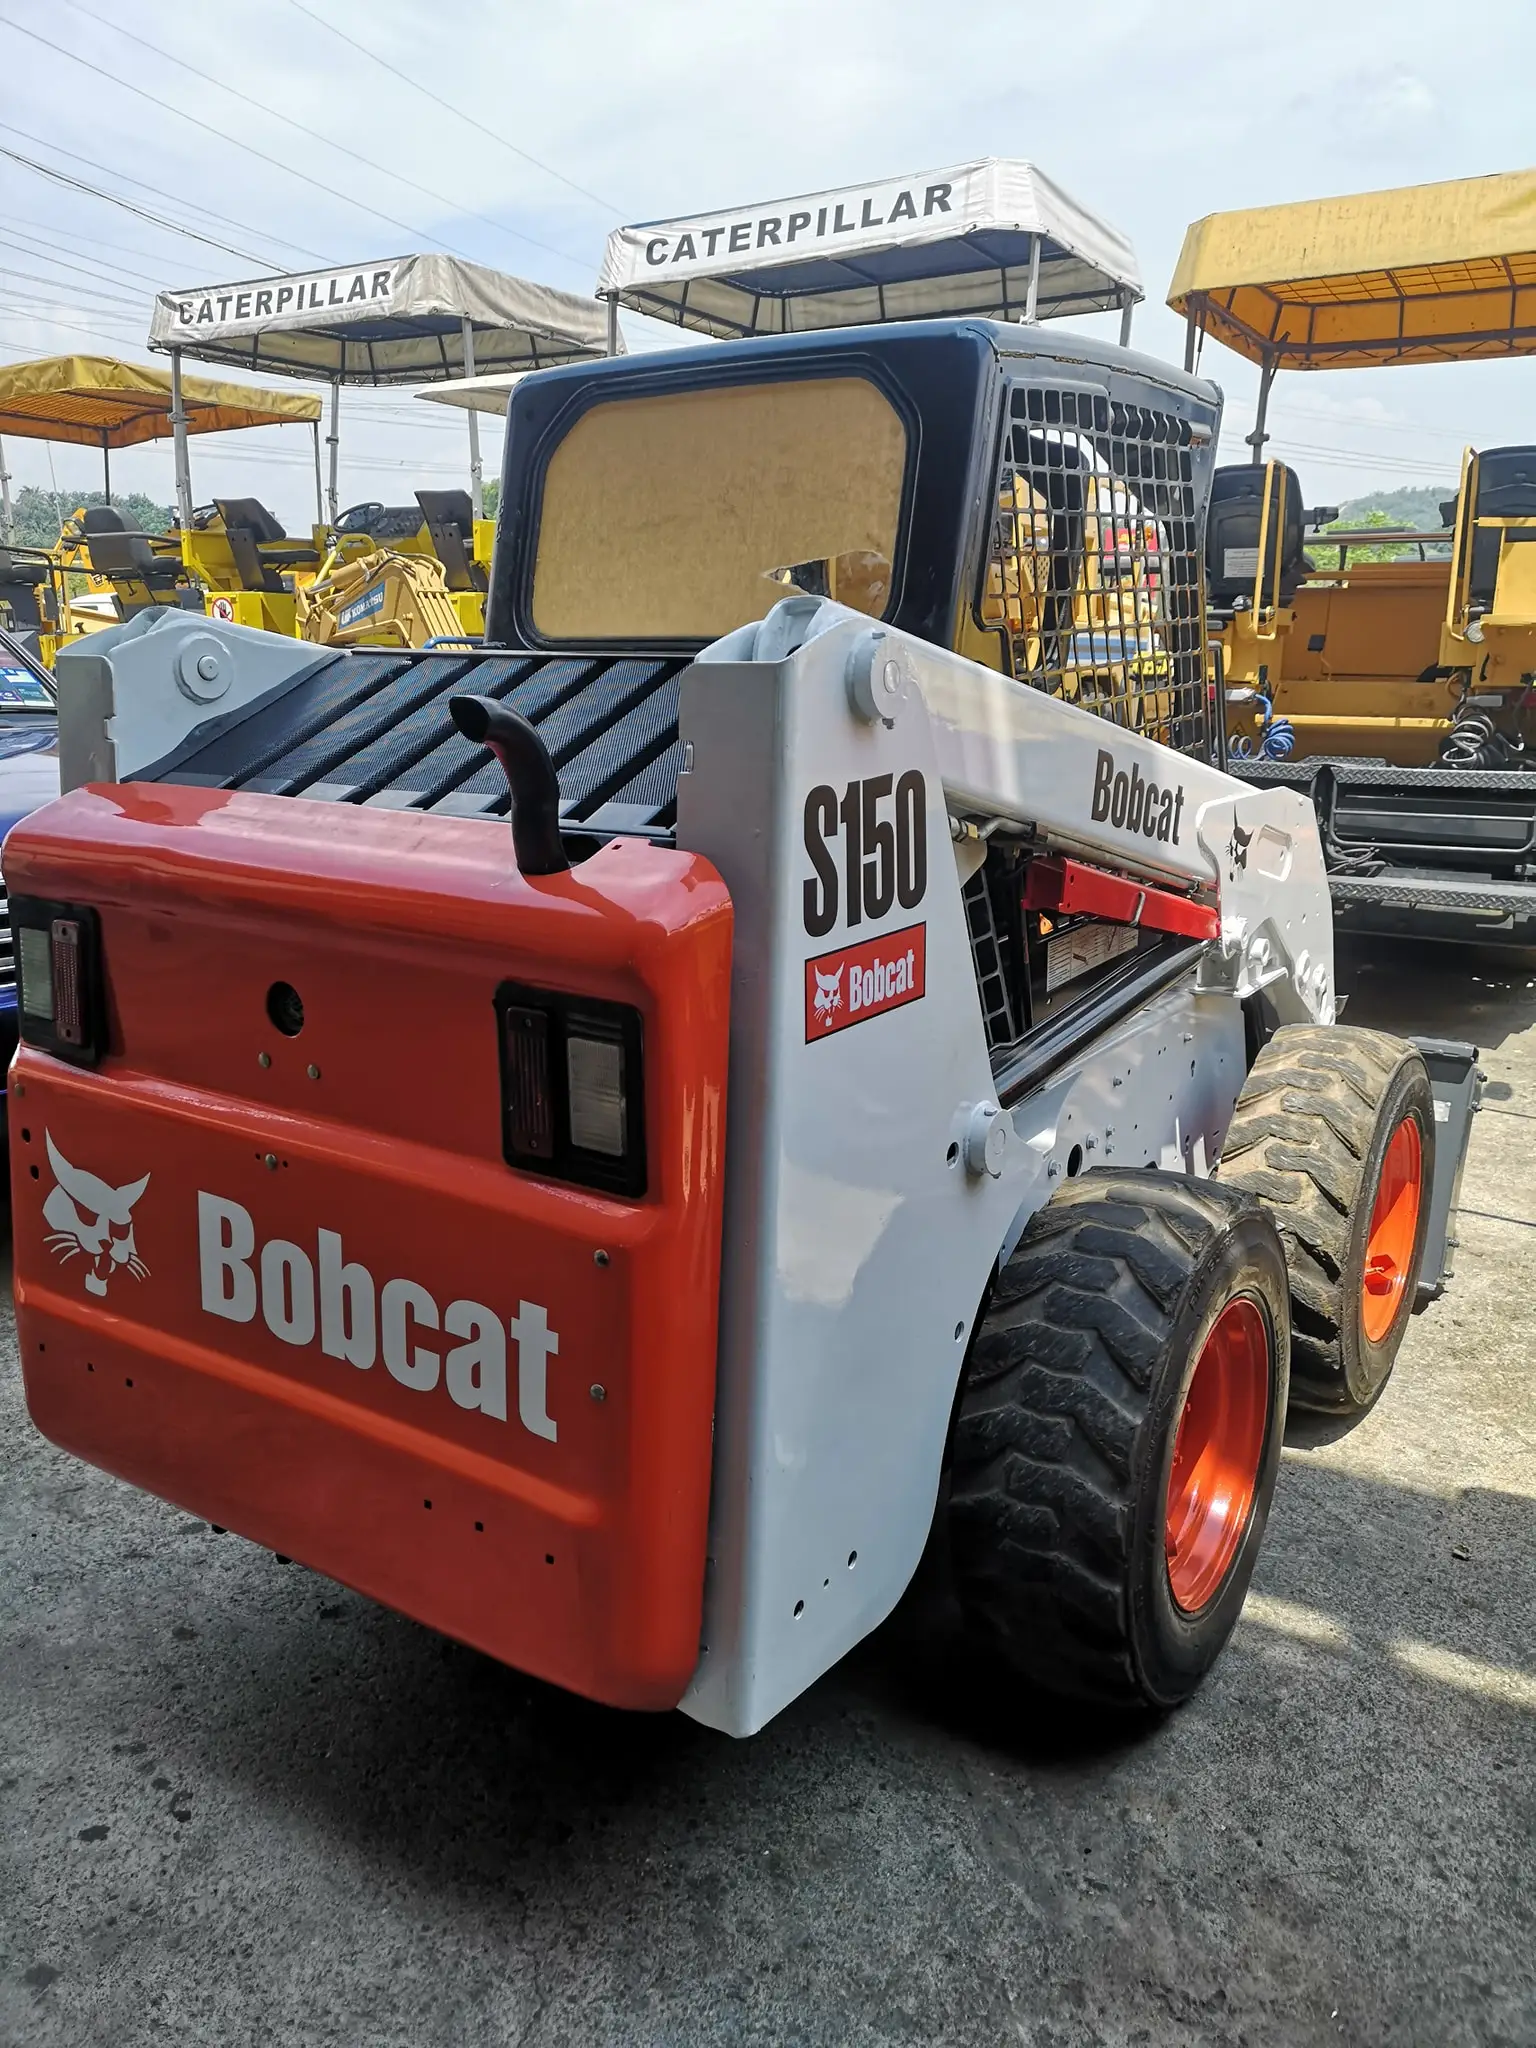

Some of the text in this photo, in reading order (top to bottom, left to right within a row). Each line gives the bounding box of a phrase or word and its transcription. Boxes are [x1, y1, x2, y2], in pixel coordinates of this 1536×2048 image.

[645, 183, 954, 266] CATERPILLAR
[178, 270, 392, 326] CATERPILLAR
[351, 591, 384, 618] KOMATSU
[1091, 748, 1185, 846] Bobcat
[803, 769, 928, 938] S150
[849, 949, 915, 1013] Bobcat
[197, 1189, 560, 1444] Bobcat
